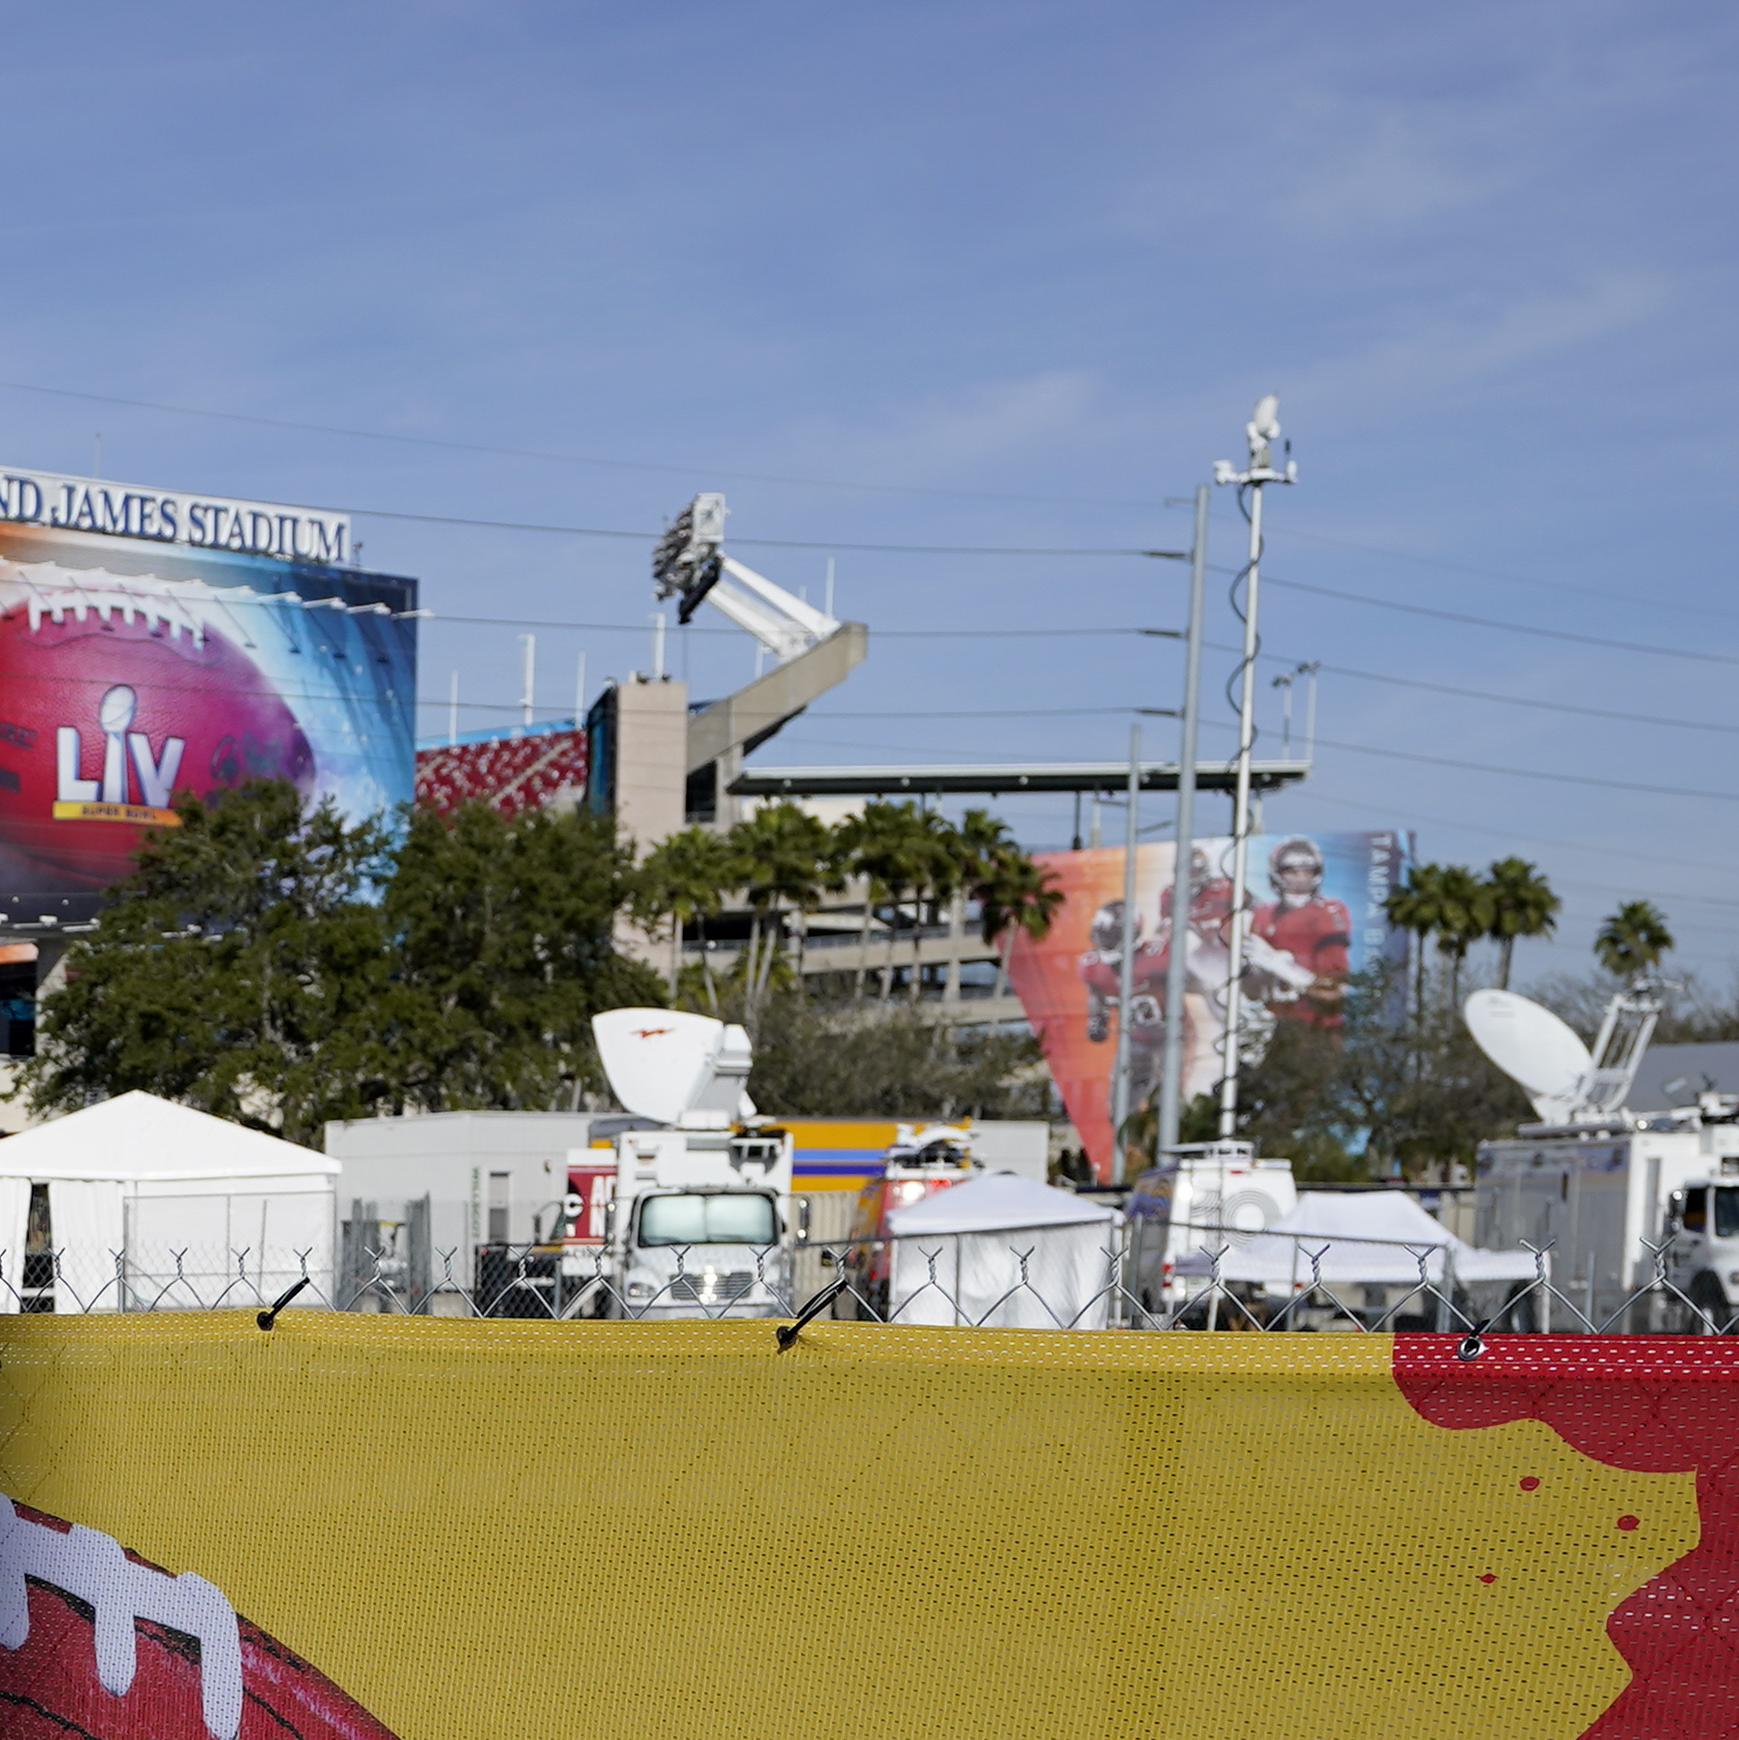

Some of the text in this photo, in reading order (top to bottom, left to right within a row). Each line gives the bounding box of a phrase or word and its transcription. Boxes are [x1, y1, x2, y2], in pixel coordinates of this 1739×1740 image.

[51, 483, 178, 540] JAMES
[188, 505, 347, 561] STADIUM
[55, 683, 186, 809] LIV
[1366, 832, 1392, 919] TAMPA
